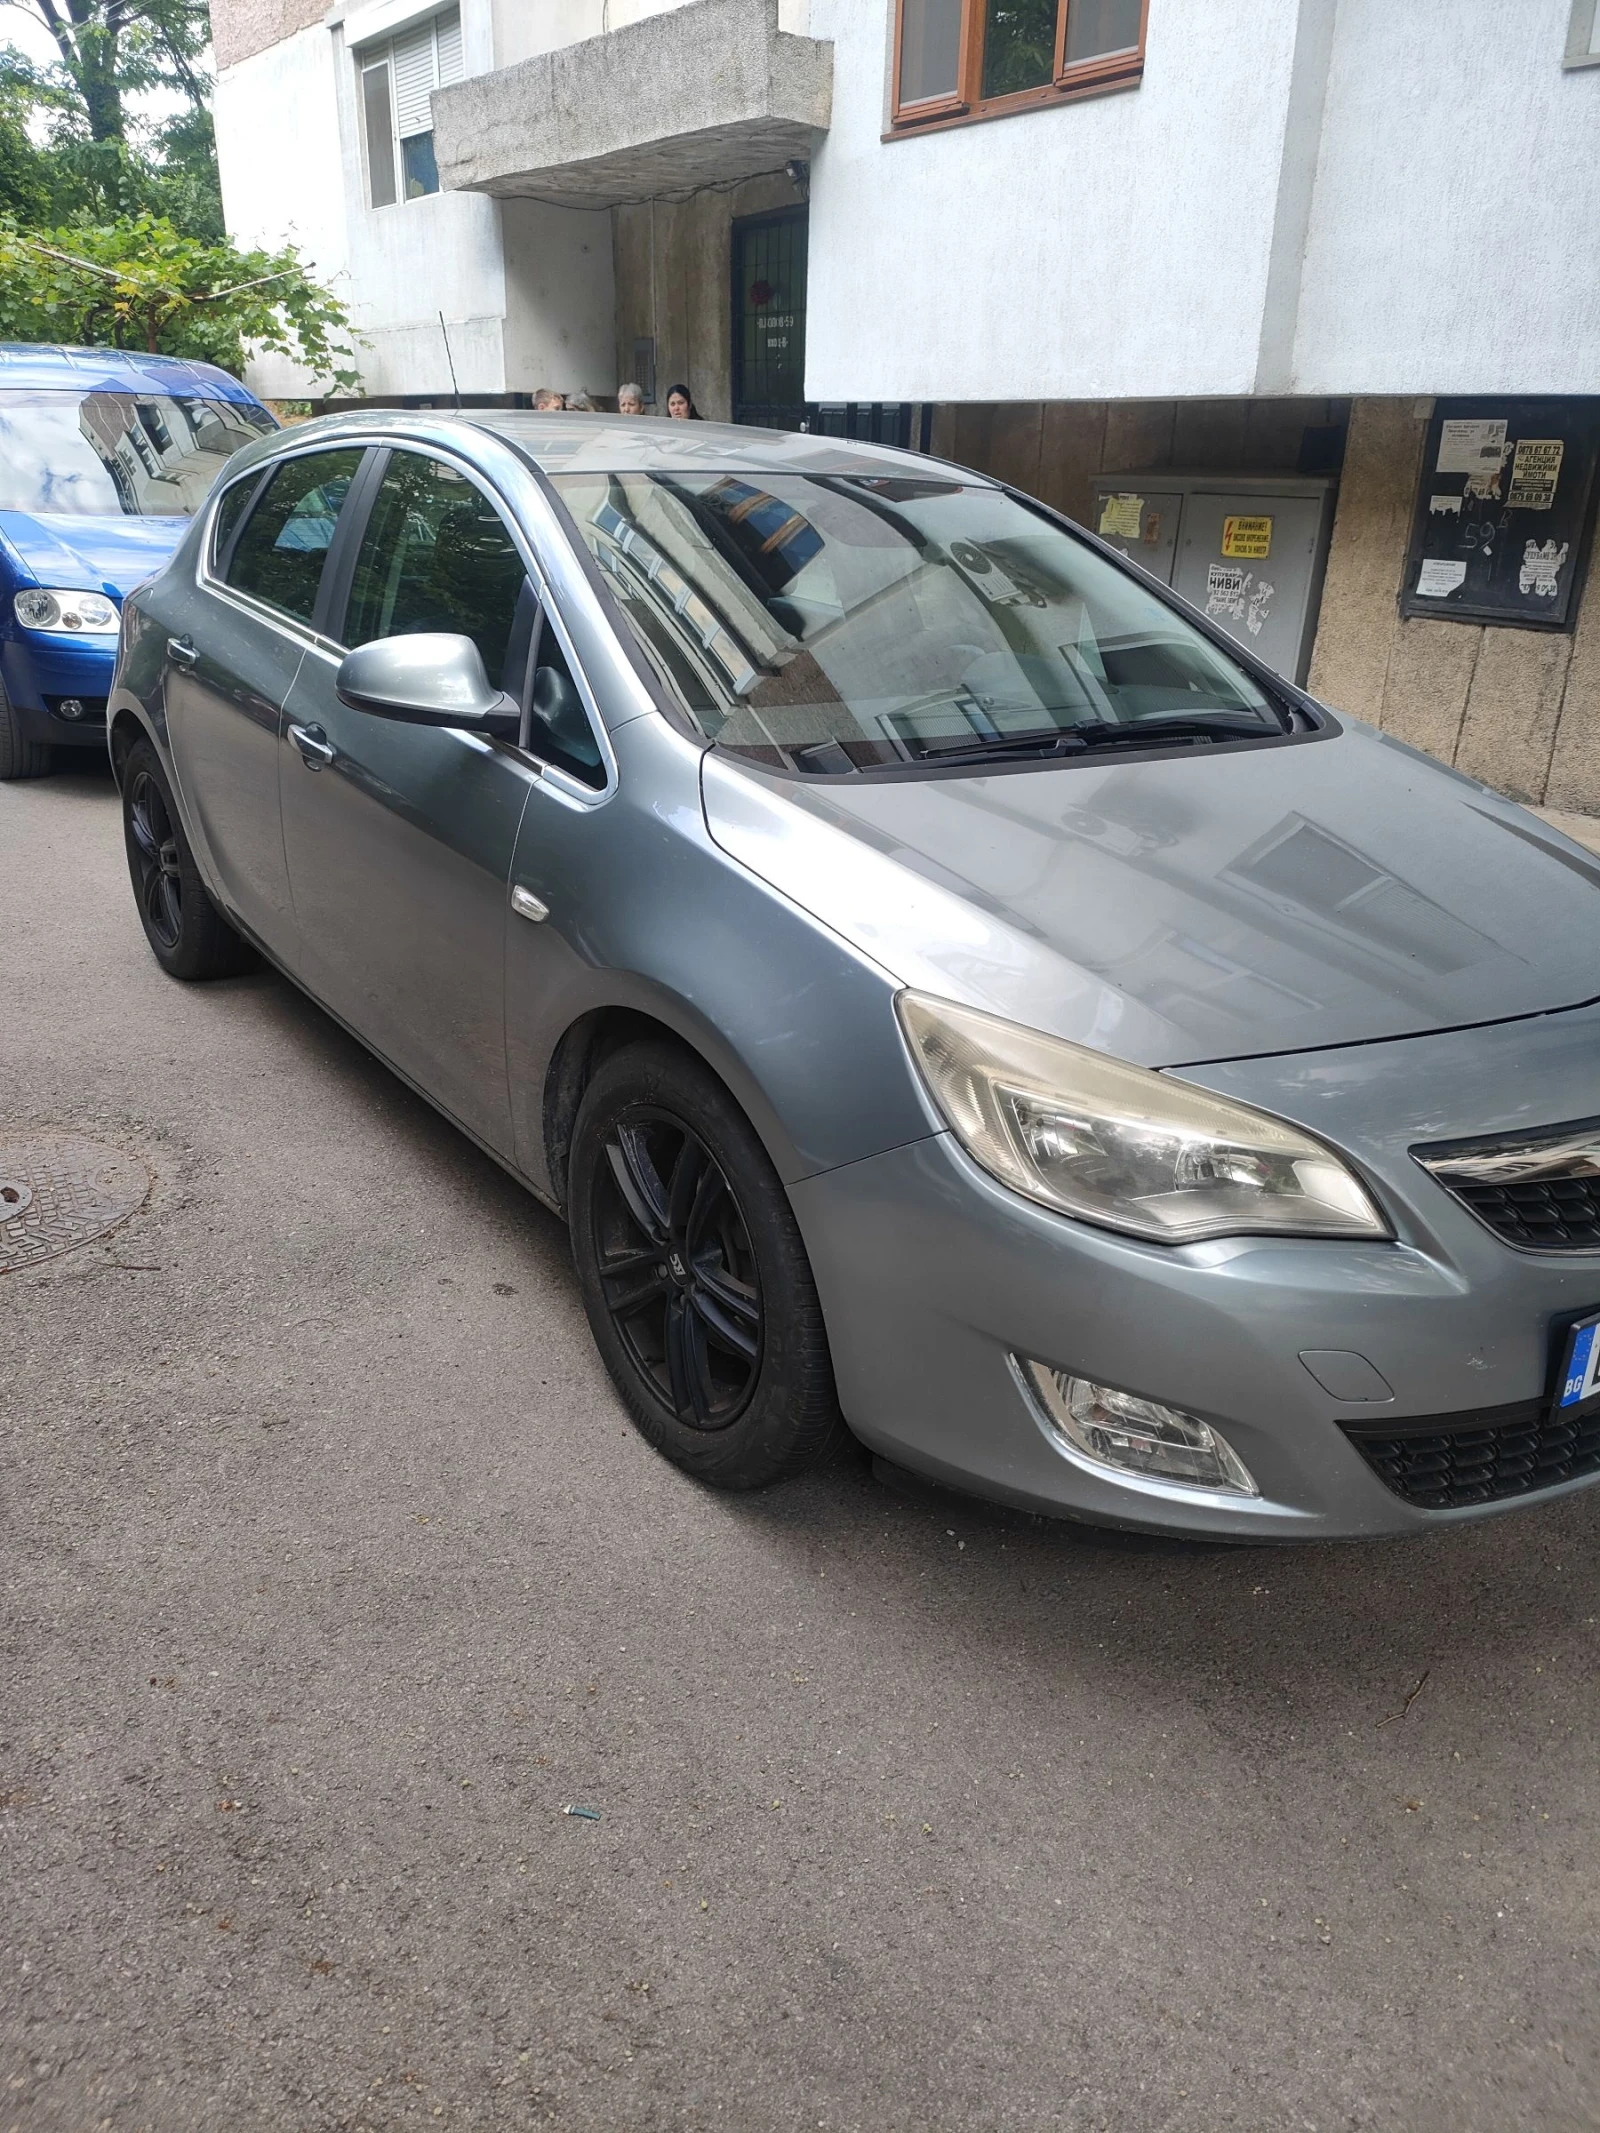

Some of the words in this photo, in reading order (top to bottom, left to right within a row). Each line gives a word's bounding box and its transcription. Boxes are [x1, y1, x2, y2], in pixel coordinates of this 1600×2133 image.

[1524, 455, 1556, 465] АГЕНЦИЯ
[1514, 463, 1558, 473] НЕДВИЖИМИ
[1522, 471, 1547, 479] ИМОТИ
[1458, 522, 1496, 550] 59
[1209, 577, 1241, 590] НИВИ
[1563, 1374, 1583, 1398] BG
